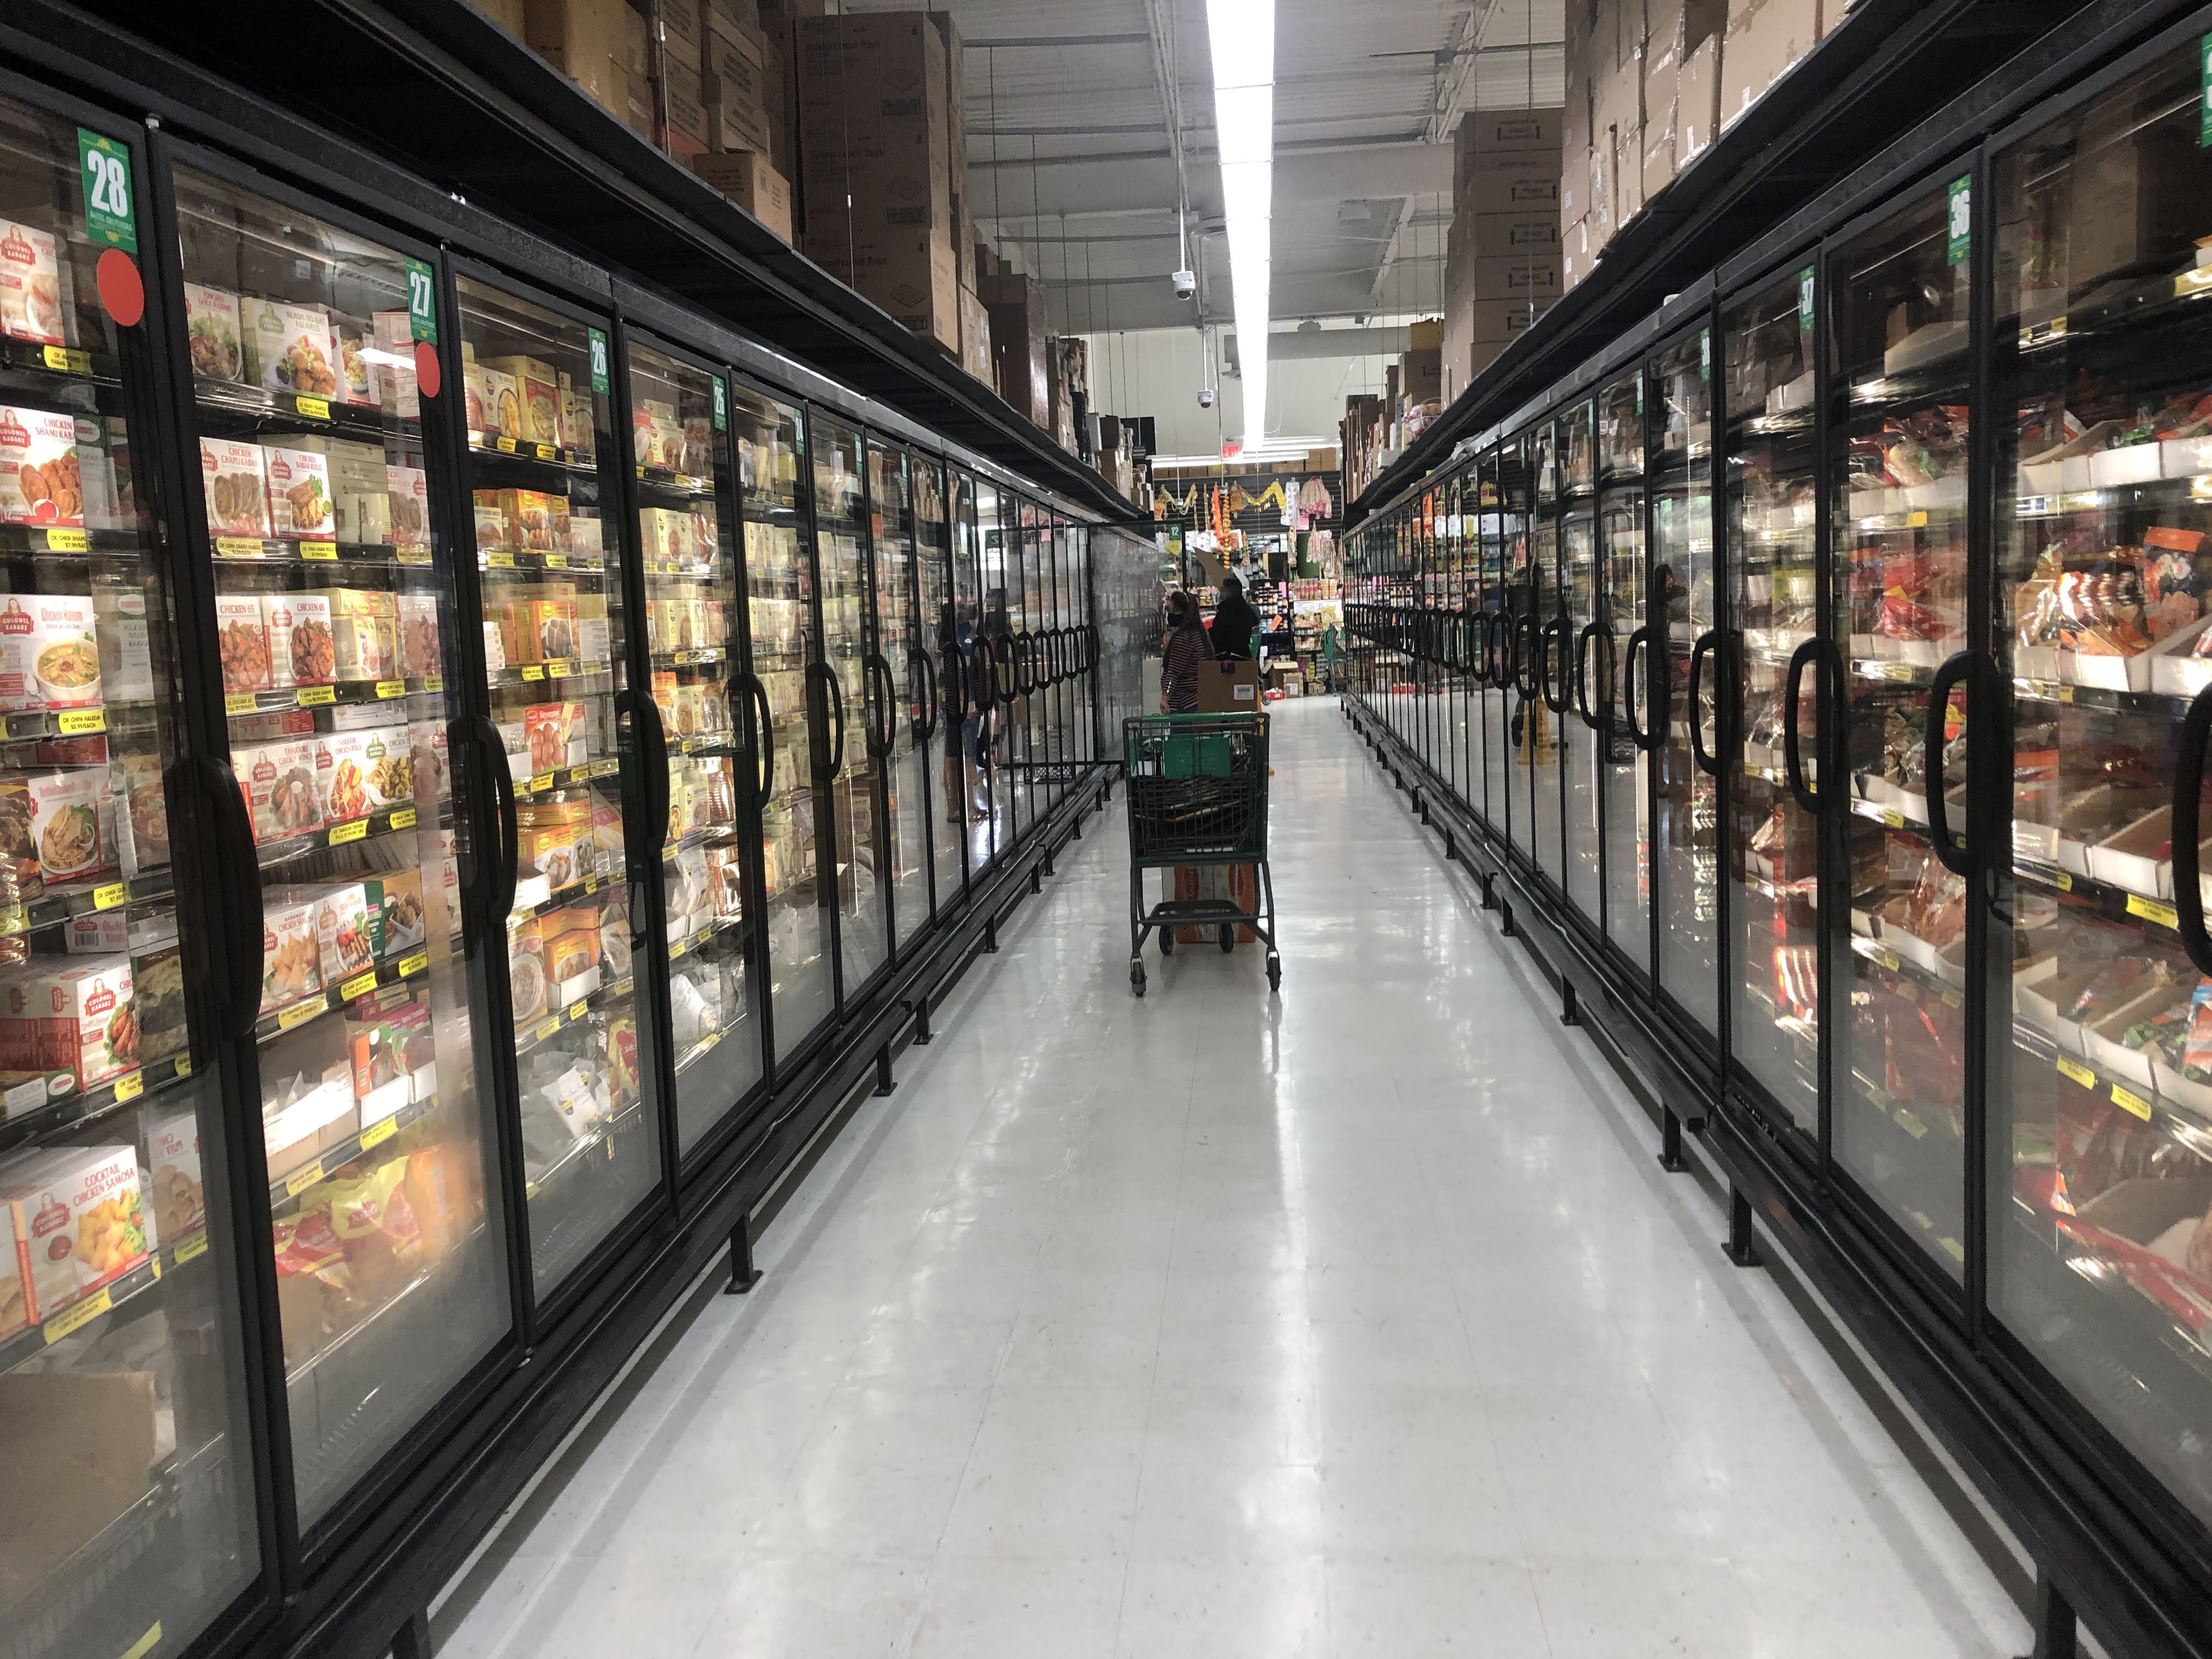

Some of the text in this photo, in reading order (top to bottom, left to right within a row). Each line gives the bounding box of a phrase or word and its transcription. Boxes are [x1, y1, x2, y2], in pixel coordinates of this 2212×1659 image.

[88, 150, 127, 217] 28
[410, 271, 431, 317] 27
[592, 339, 606, 376] 26
[714, 385, 724, 415] 25
[44, 417, 72, 431] CHICKEN
[795, 416, 804, 442] 24
[35, 427, 58, 438] SHAMI
[1222, 445, 1240, 459] EXIT
[1171, 526, 1179, 536] 12
[220, 605, 255, 614] CHICKEN 65
[297, 603, 325, 612] CHICKEN 65
[2, 617, 30, 625] COLONEL
[284, 745, 308, 755] TANDOORI
[88, 994, 112, 1007] COLONEL
[84, 1163, 121, 1188] COCKTAIL
[73, 1167, 135, 1207] CHICKEN SAMOSA
